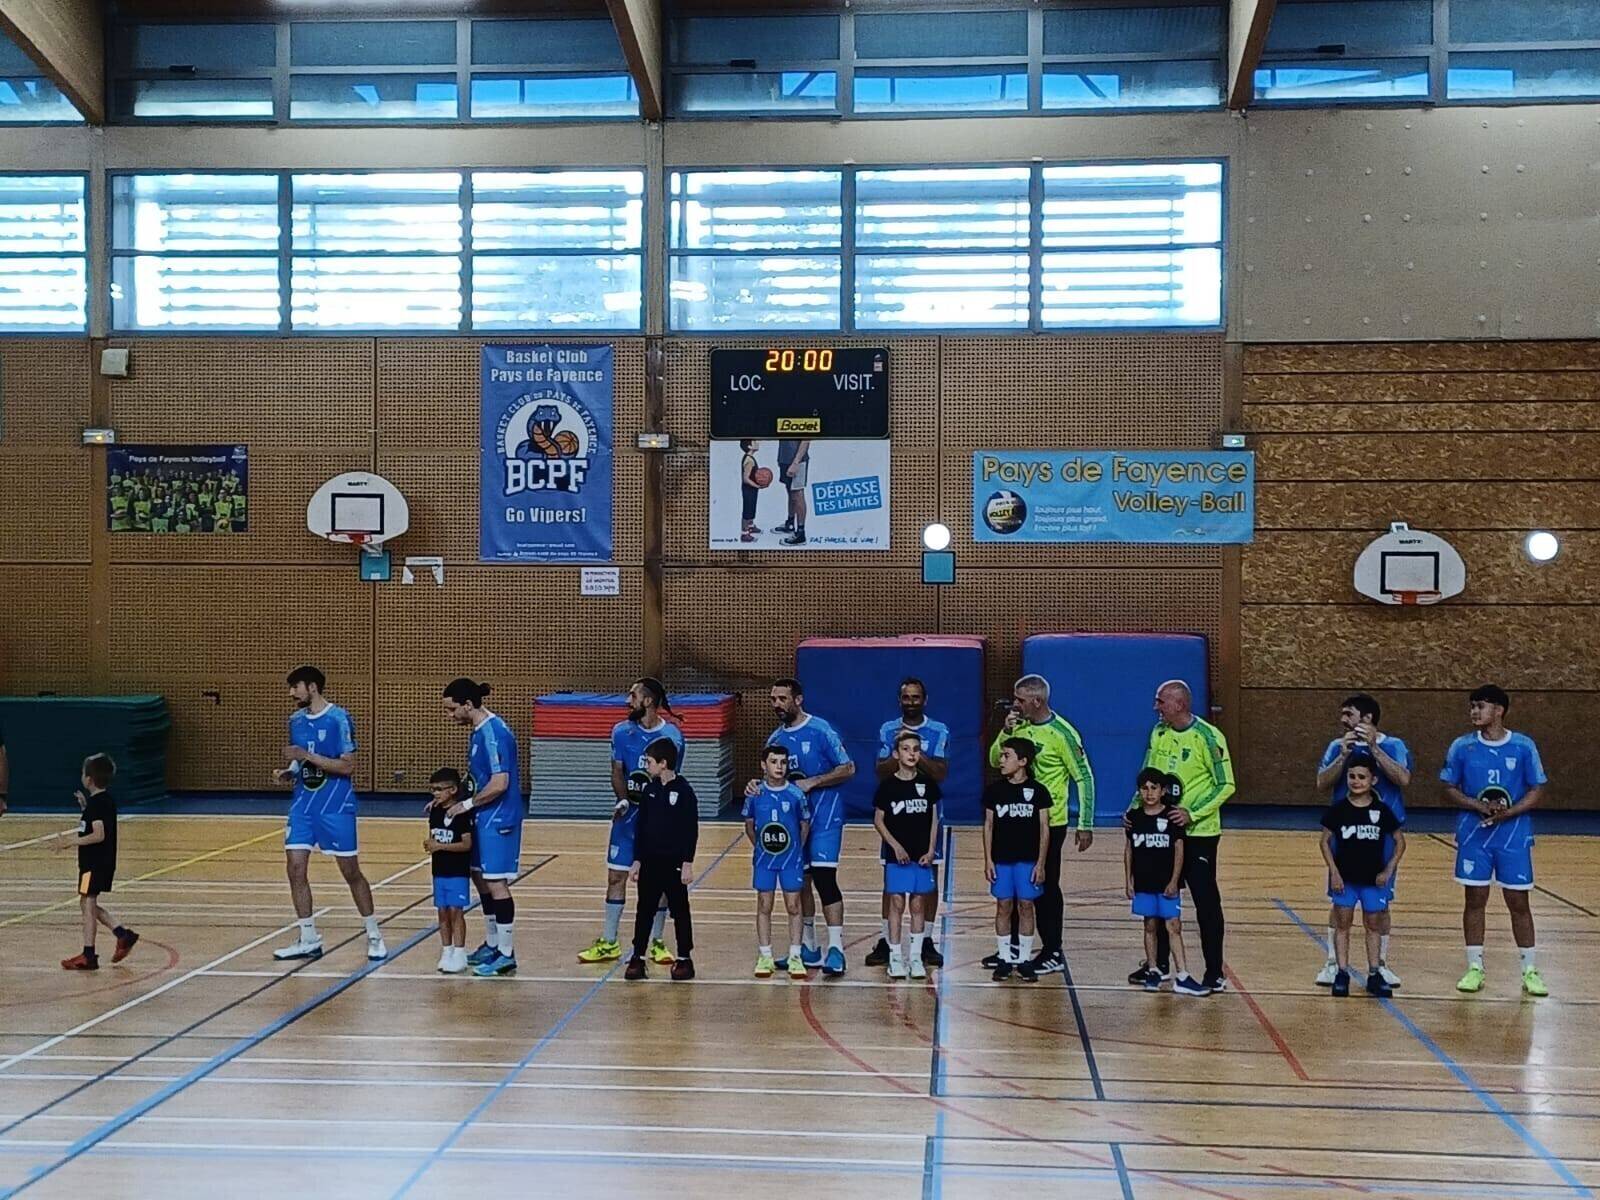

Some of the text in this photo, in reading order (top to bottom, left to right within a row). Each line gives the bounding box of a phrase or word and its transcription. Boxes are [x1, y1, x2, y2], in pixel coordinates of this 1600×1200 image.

[506, 350, 588, 363] Basket Club
[766, 350, 832, 371] 20:00
[491, 369, 603, 383] Pays de Fayence
[730, 375, 765, 391] LOC.
[833, 374, 875, 390] VISIT.
[508, 394, 531, 414] CLUB
[546, 389, 572, 403] PAYS
[780, 420, 818, 431] Bodet
[505, 459, 589, 496] BCPF
[982, 456, 1247, 487] Pays de Fayence
[815, 479, 879, 500] DÉPASSE
[816, 495, 879, 512] TES LIMITES
[1112, 490, 1246, 516] Volley-Ball
[506, 507, 586, 524] Go Vipers!
[1488, 769, 1500, 784] 21
